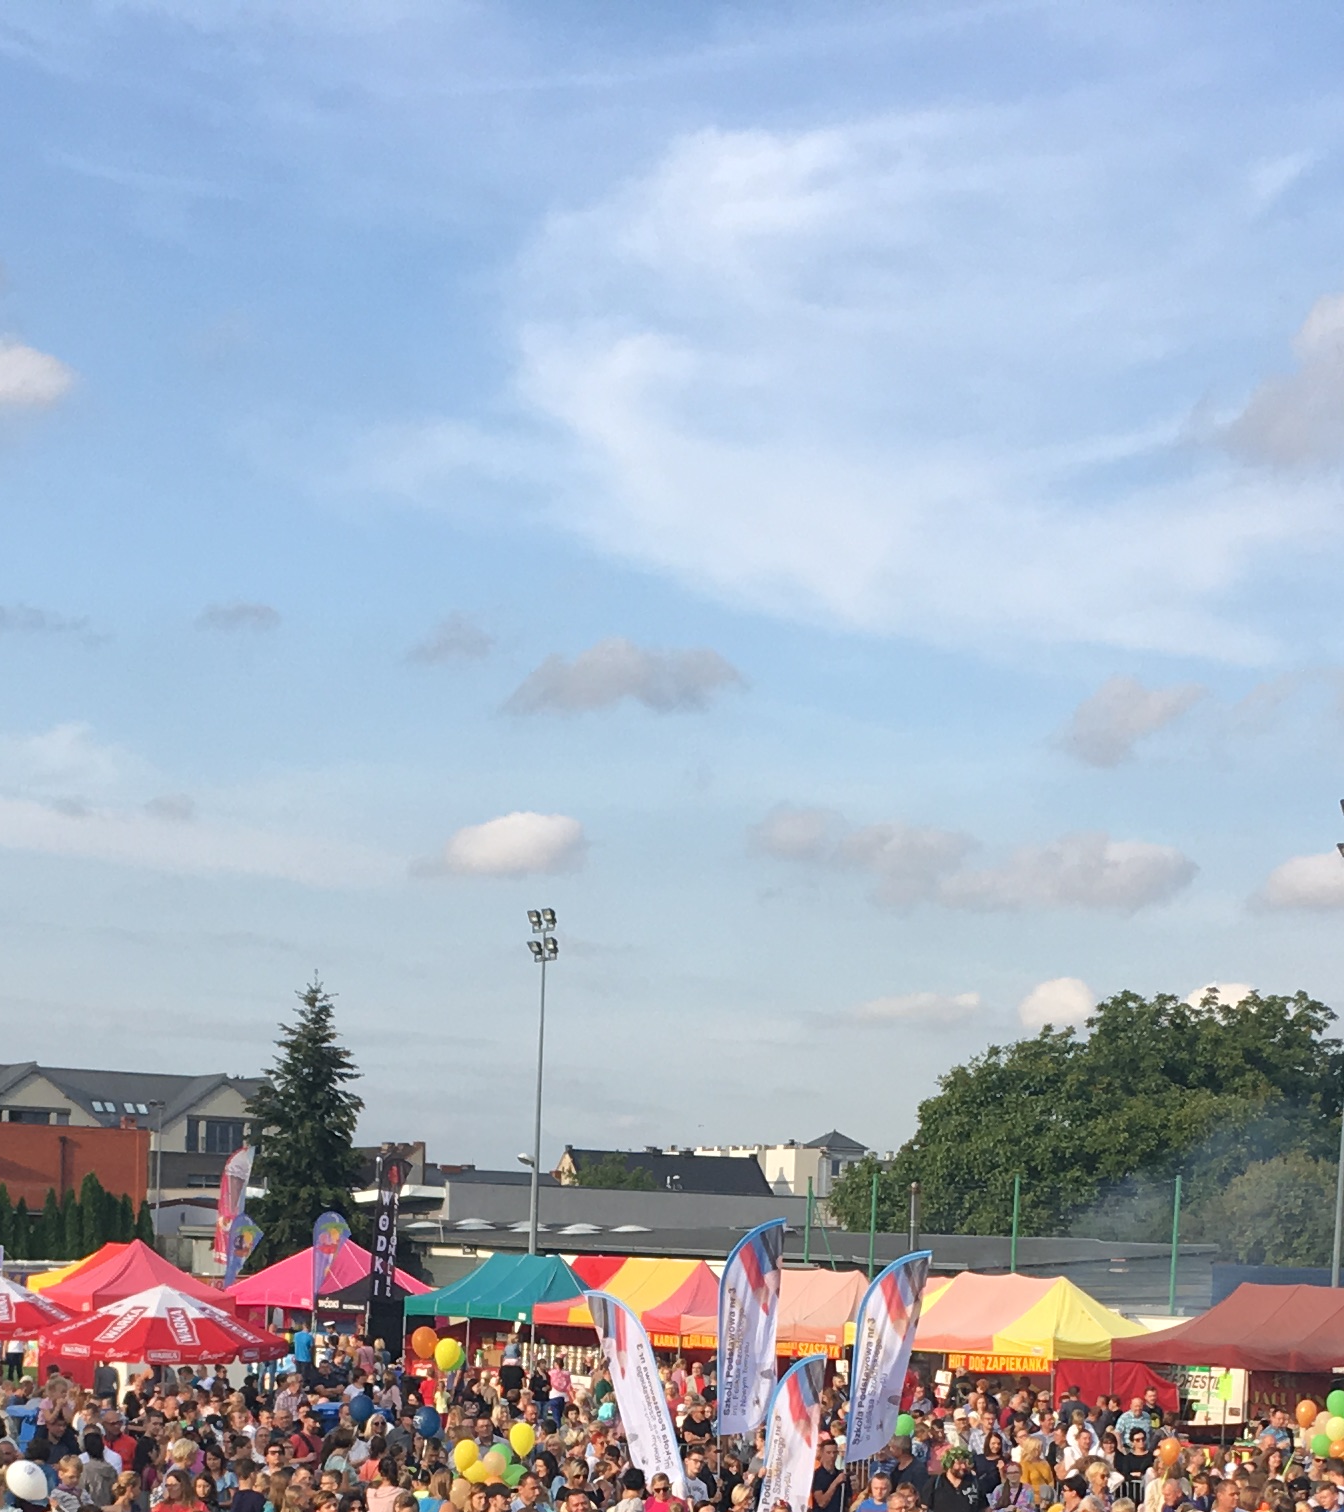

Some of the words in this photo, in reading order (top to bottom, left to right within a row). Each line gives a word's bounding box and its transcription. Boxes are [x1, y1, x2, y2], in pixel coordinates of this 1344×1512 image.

[100, 1308, 144, 1339] WARKA
[169, 1309, 194, 1343] WARKA
[948, 1354, 967, 1369] HOT
[986, 1356, 1049, 1372] ZAPIEKANKA
